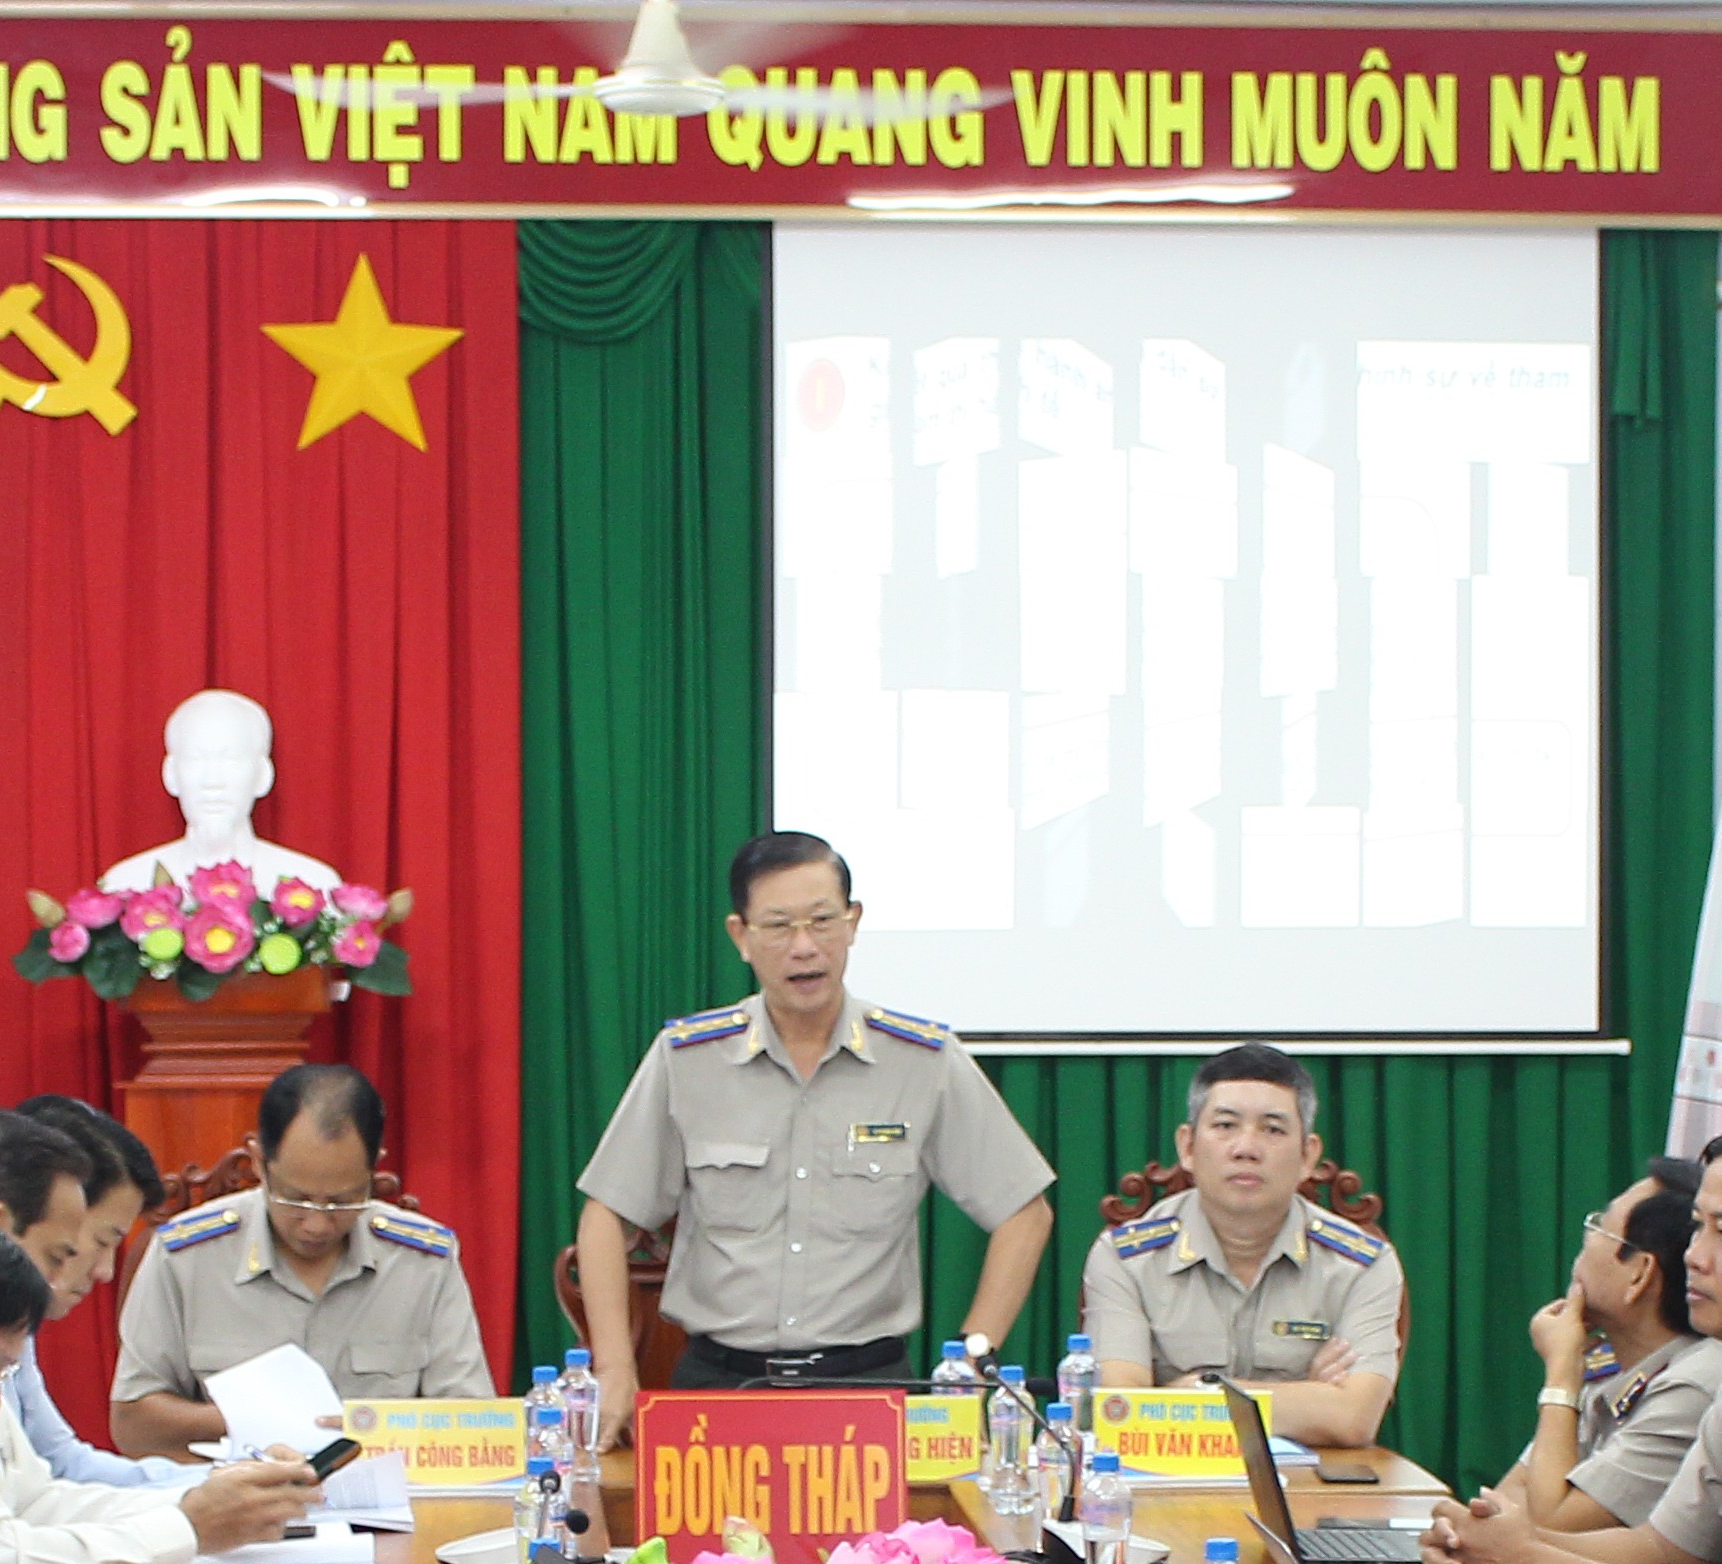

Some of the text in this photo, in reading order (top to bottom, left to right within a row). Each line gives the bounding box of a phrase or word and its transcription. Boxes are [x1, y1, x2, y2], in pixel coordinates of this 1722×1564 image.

[100, 26, 262, 164] SẢN
[291, 40, 476, 189] VIỆT
[503, 66, 678, 164] NAM
[707, 67, 985, 170] QUANG
[1011, 70, 1204, 168] VINH
[1231, 48, 1458, 172] MUÔN
[1489, 53, 1660, 173] NĂM
[654, 1413, 891, 1536] ĐỒNG THÁP
